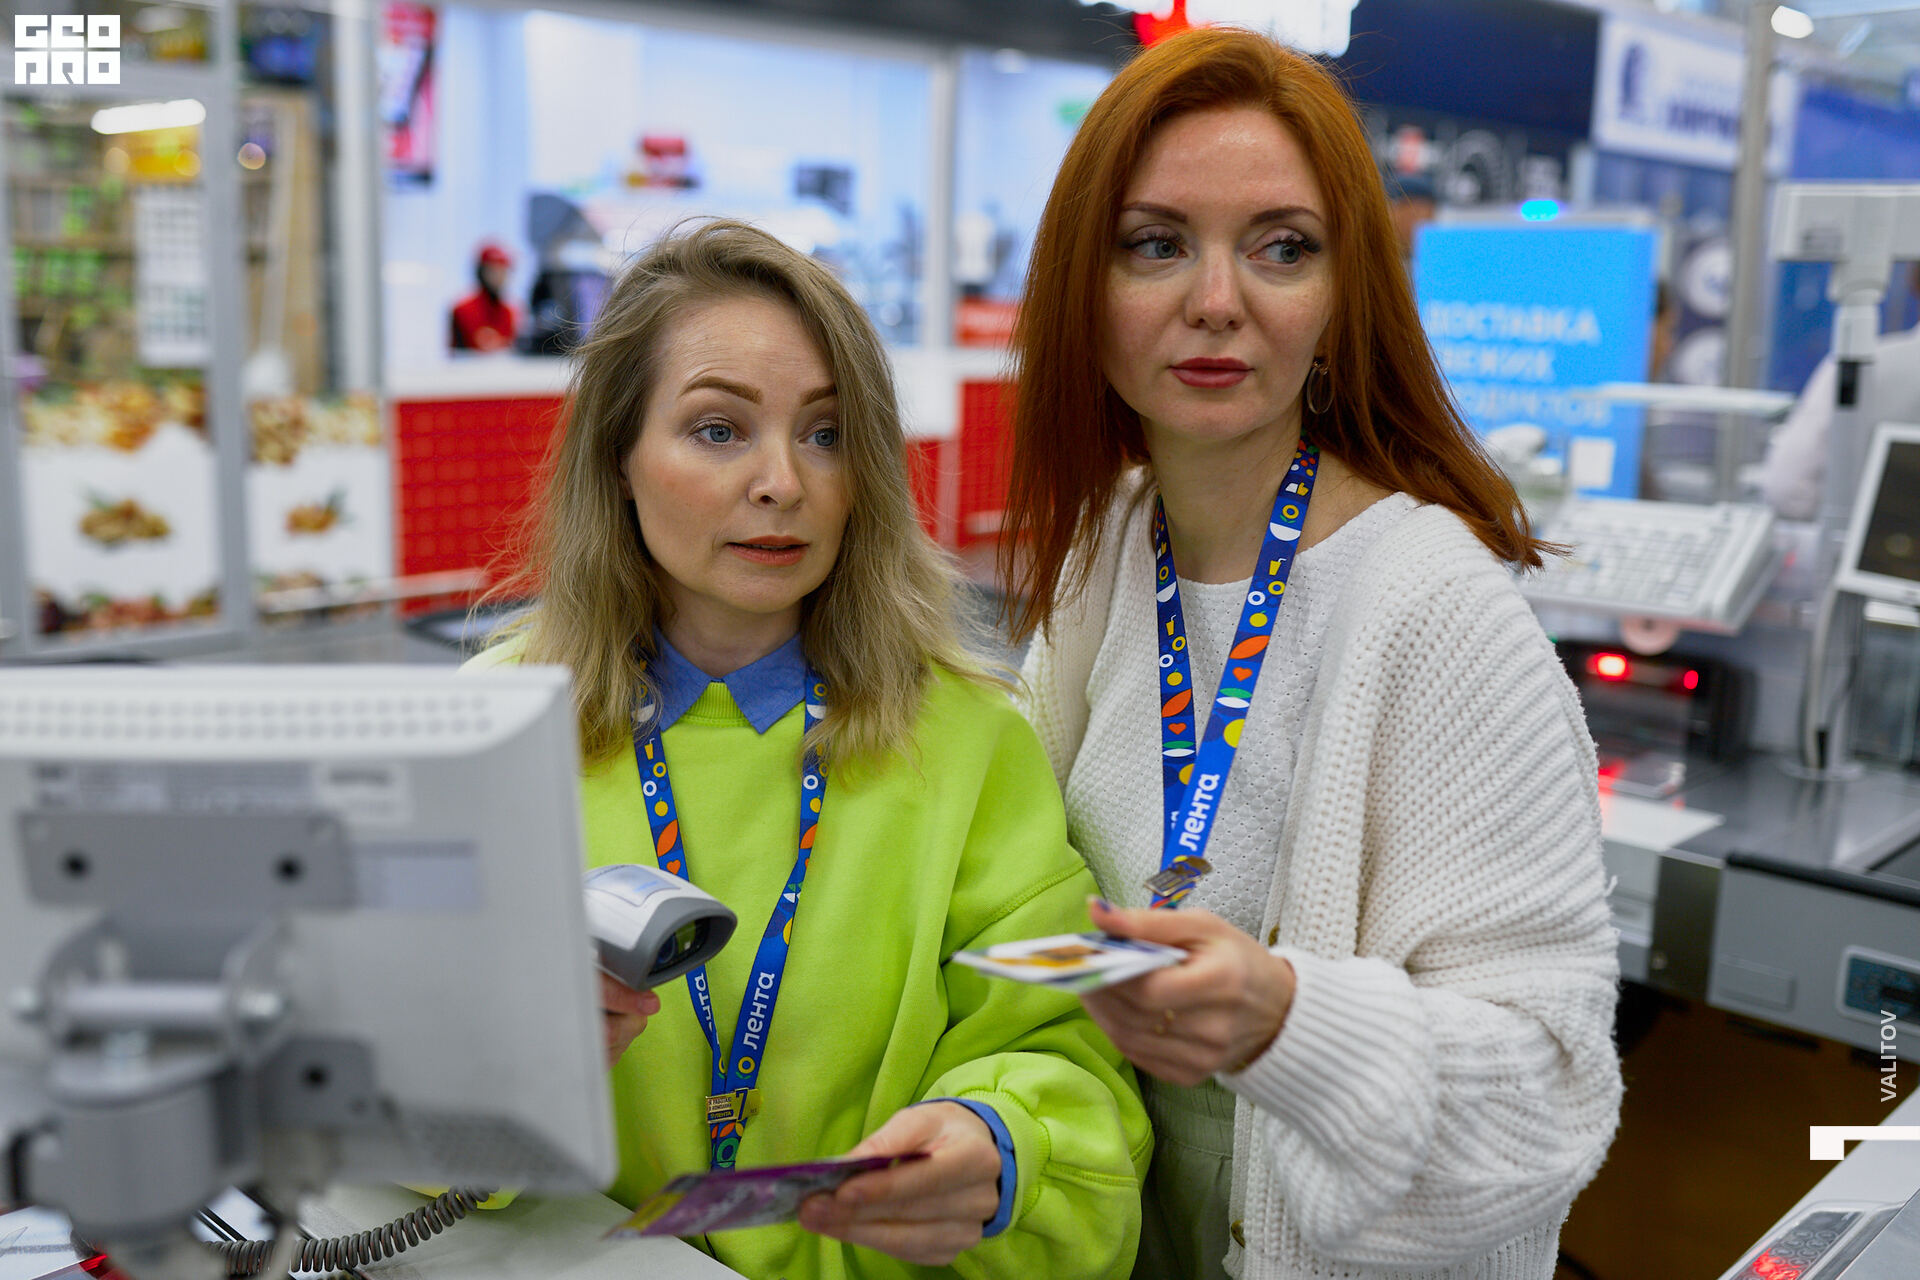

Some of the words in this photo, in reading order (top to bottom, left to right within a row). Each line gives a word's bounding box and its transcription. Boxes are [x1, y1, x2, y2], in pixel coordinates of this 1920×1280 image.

[1441, 345, 1555, 382] ВЕЖИХ
[1179, 773, 1220, 851] лента
[743, 972, 775, 1050] лента
[736, 1089, 748, 1120] 7
